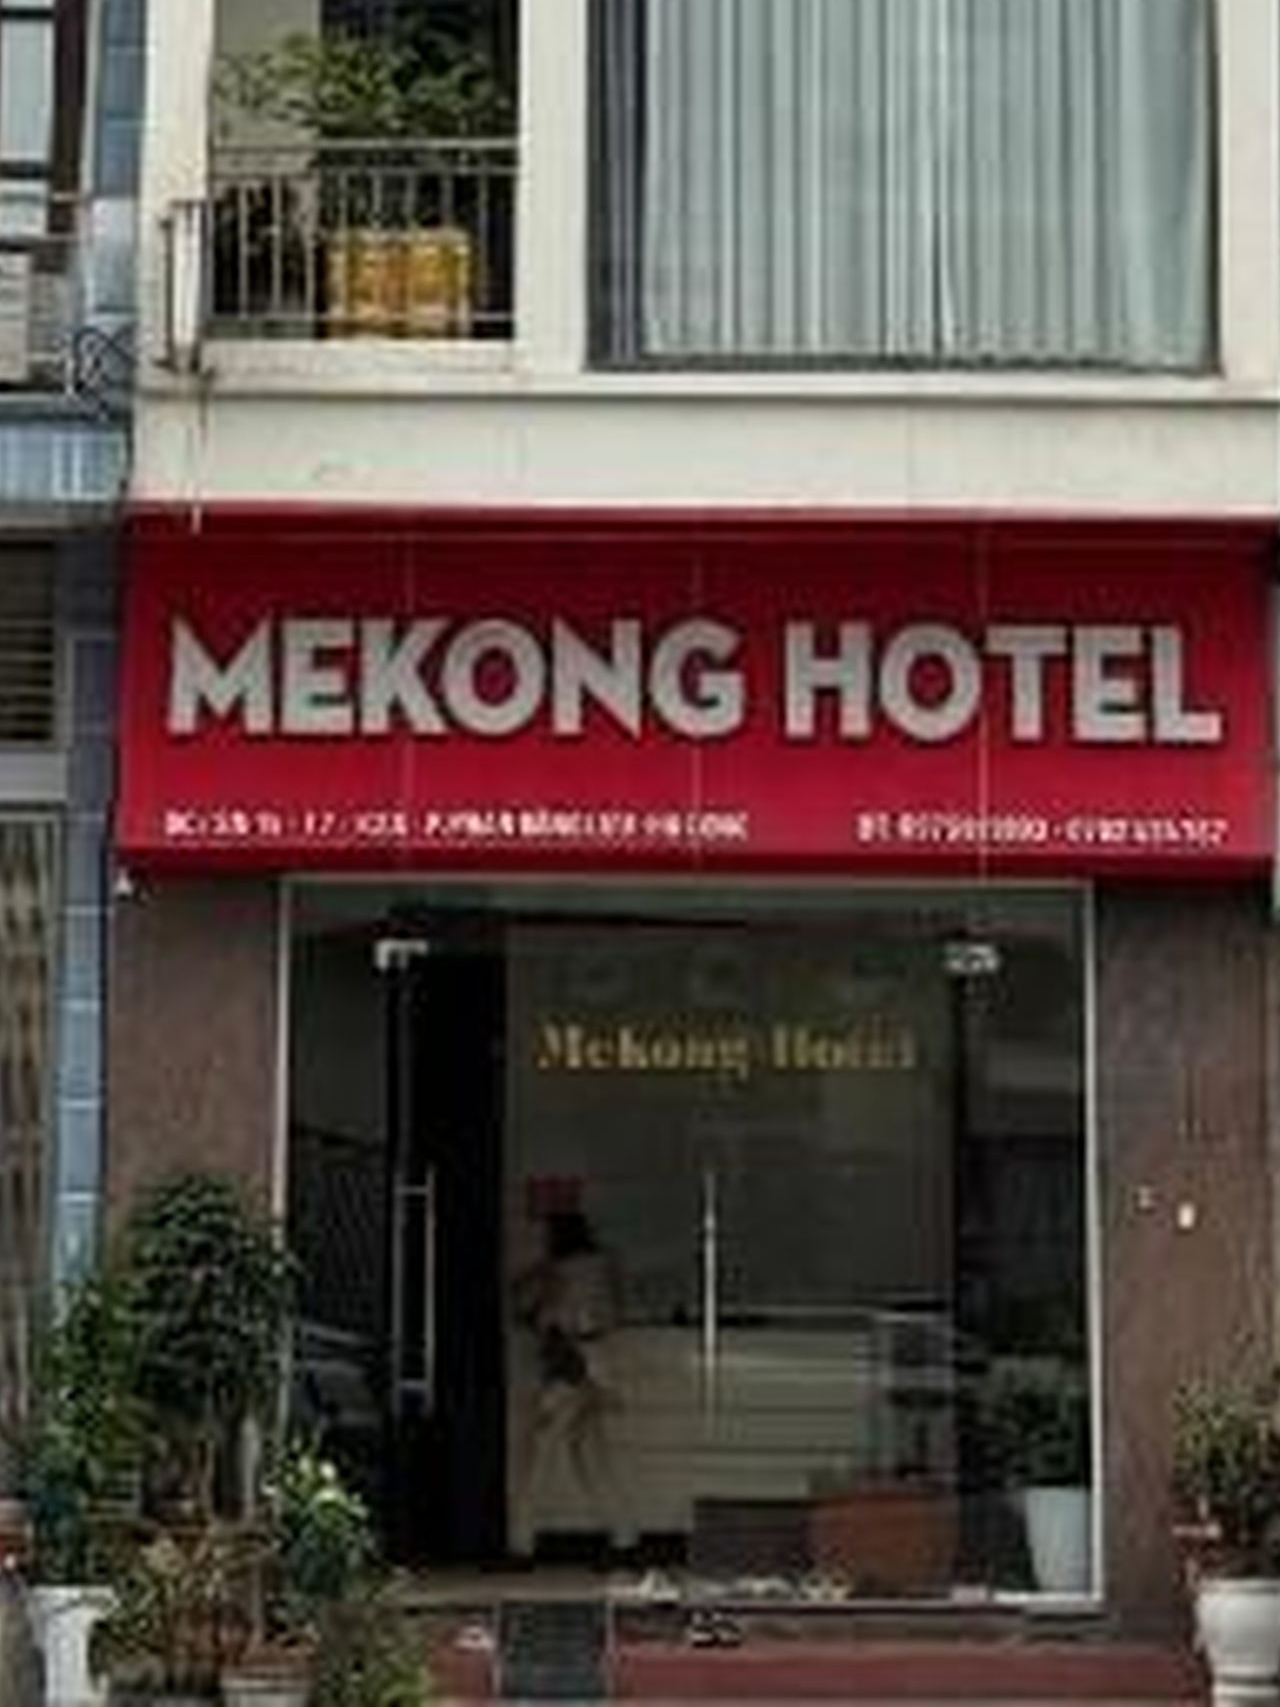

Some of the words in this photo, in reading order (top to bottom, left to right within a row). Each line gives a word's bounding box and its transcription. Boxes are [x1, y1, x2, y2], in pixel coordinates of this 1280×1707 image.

[166, 620, 745, 737] MEKONG
[784, 623, 1222, 742] HOTEL
[538, 1024, 749, 1081] Mekong
